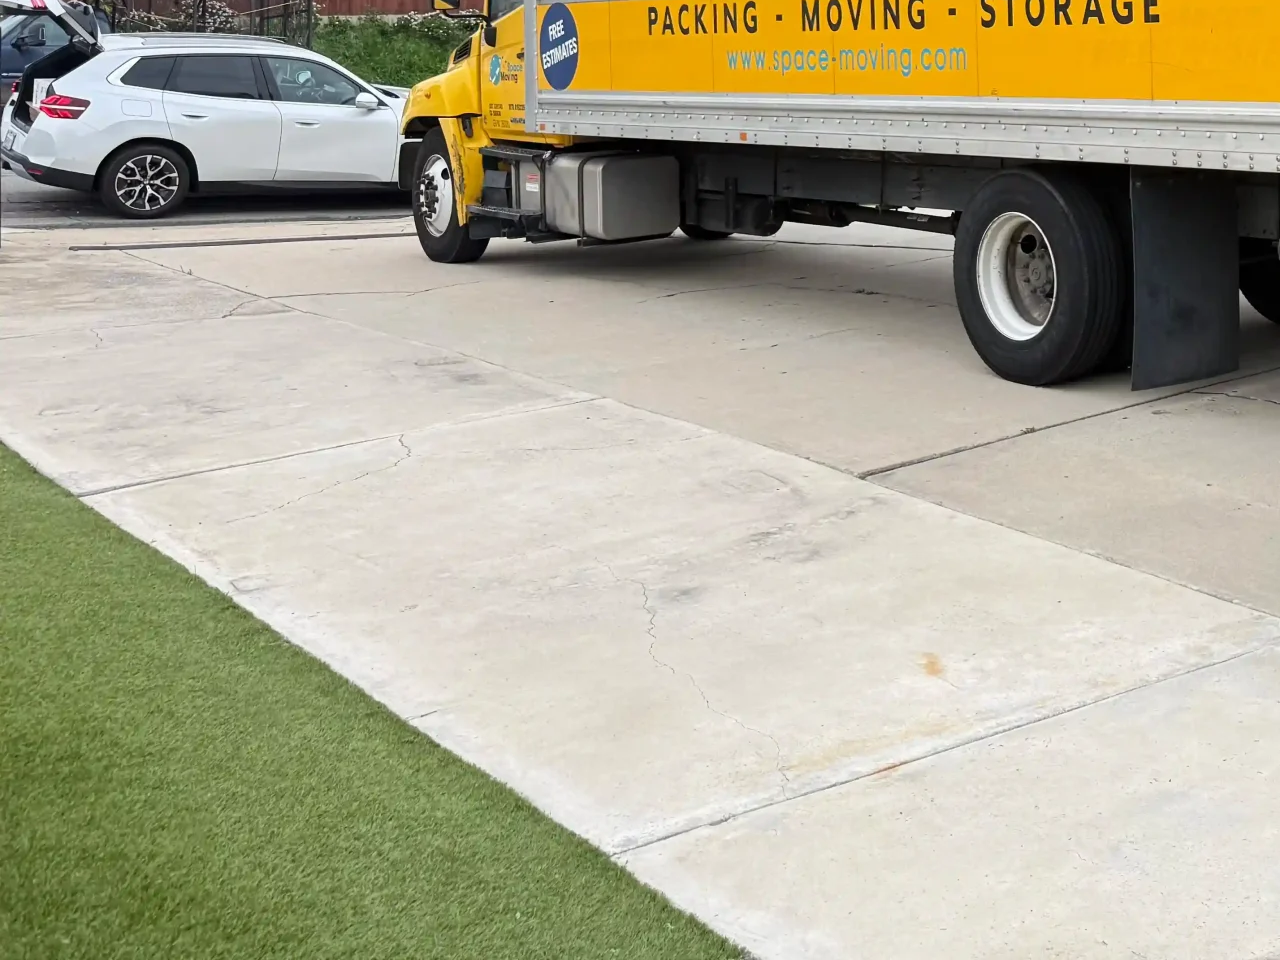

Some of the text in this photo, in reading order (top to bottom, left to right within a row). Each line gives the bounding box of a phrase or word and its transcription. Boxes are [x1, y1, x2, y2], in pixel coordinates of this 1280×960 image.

[548, 19, 565, 42] FREE
[647, 0, 758, 36] PACKING
[542, 36, 578, 70] ESTIMATES
[726, 44, 968, 78] www.space-moving.com
